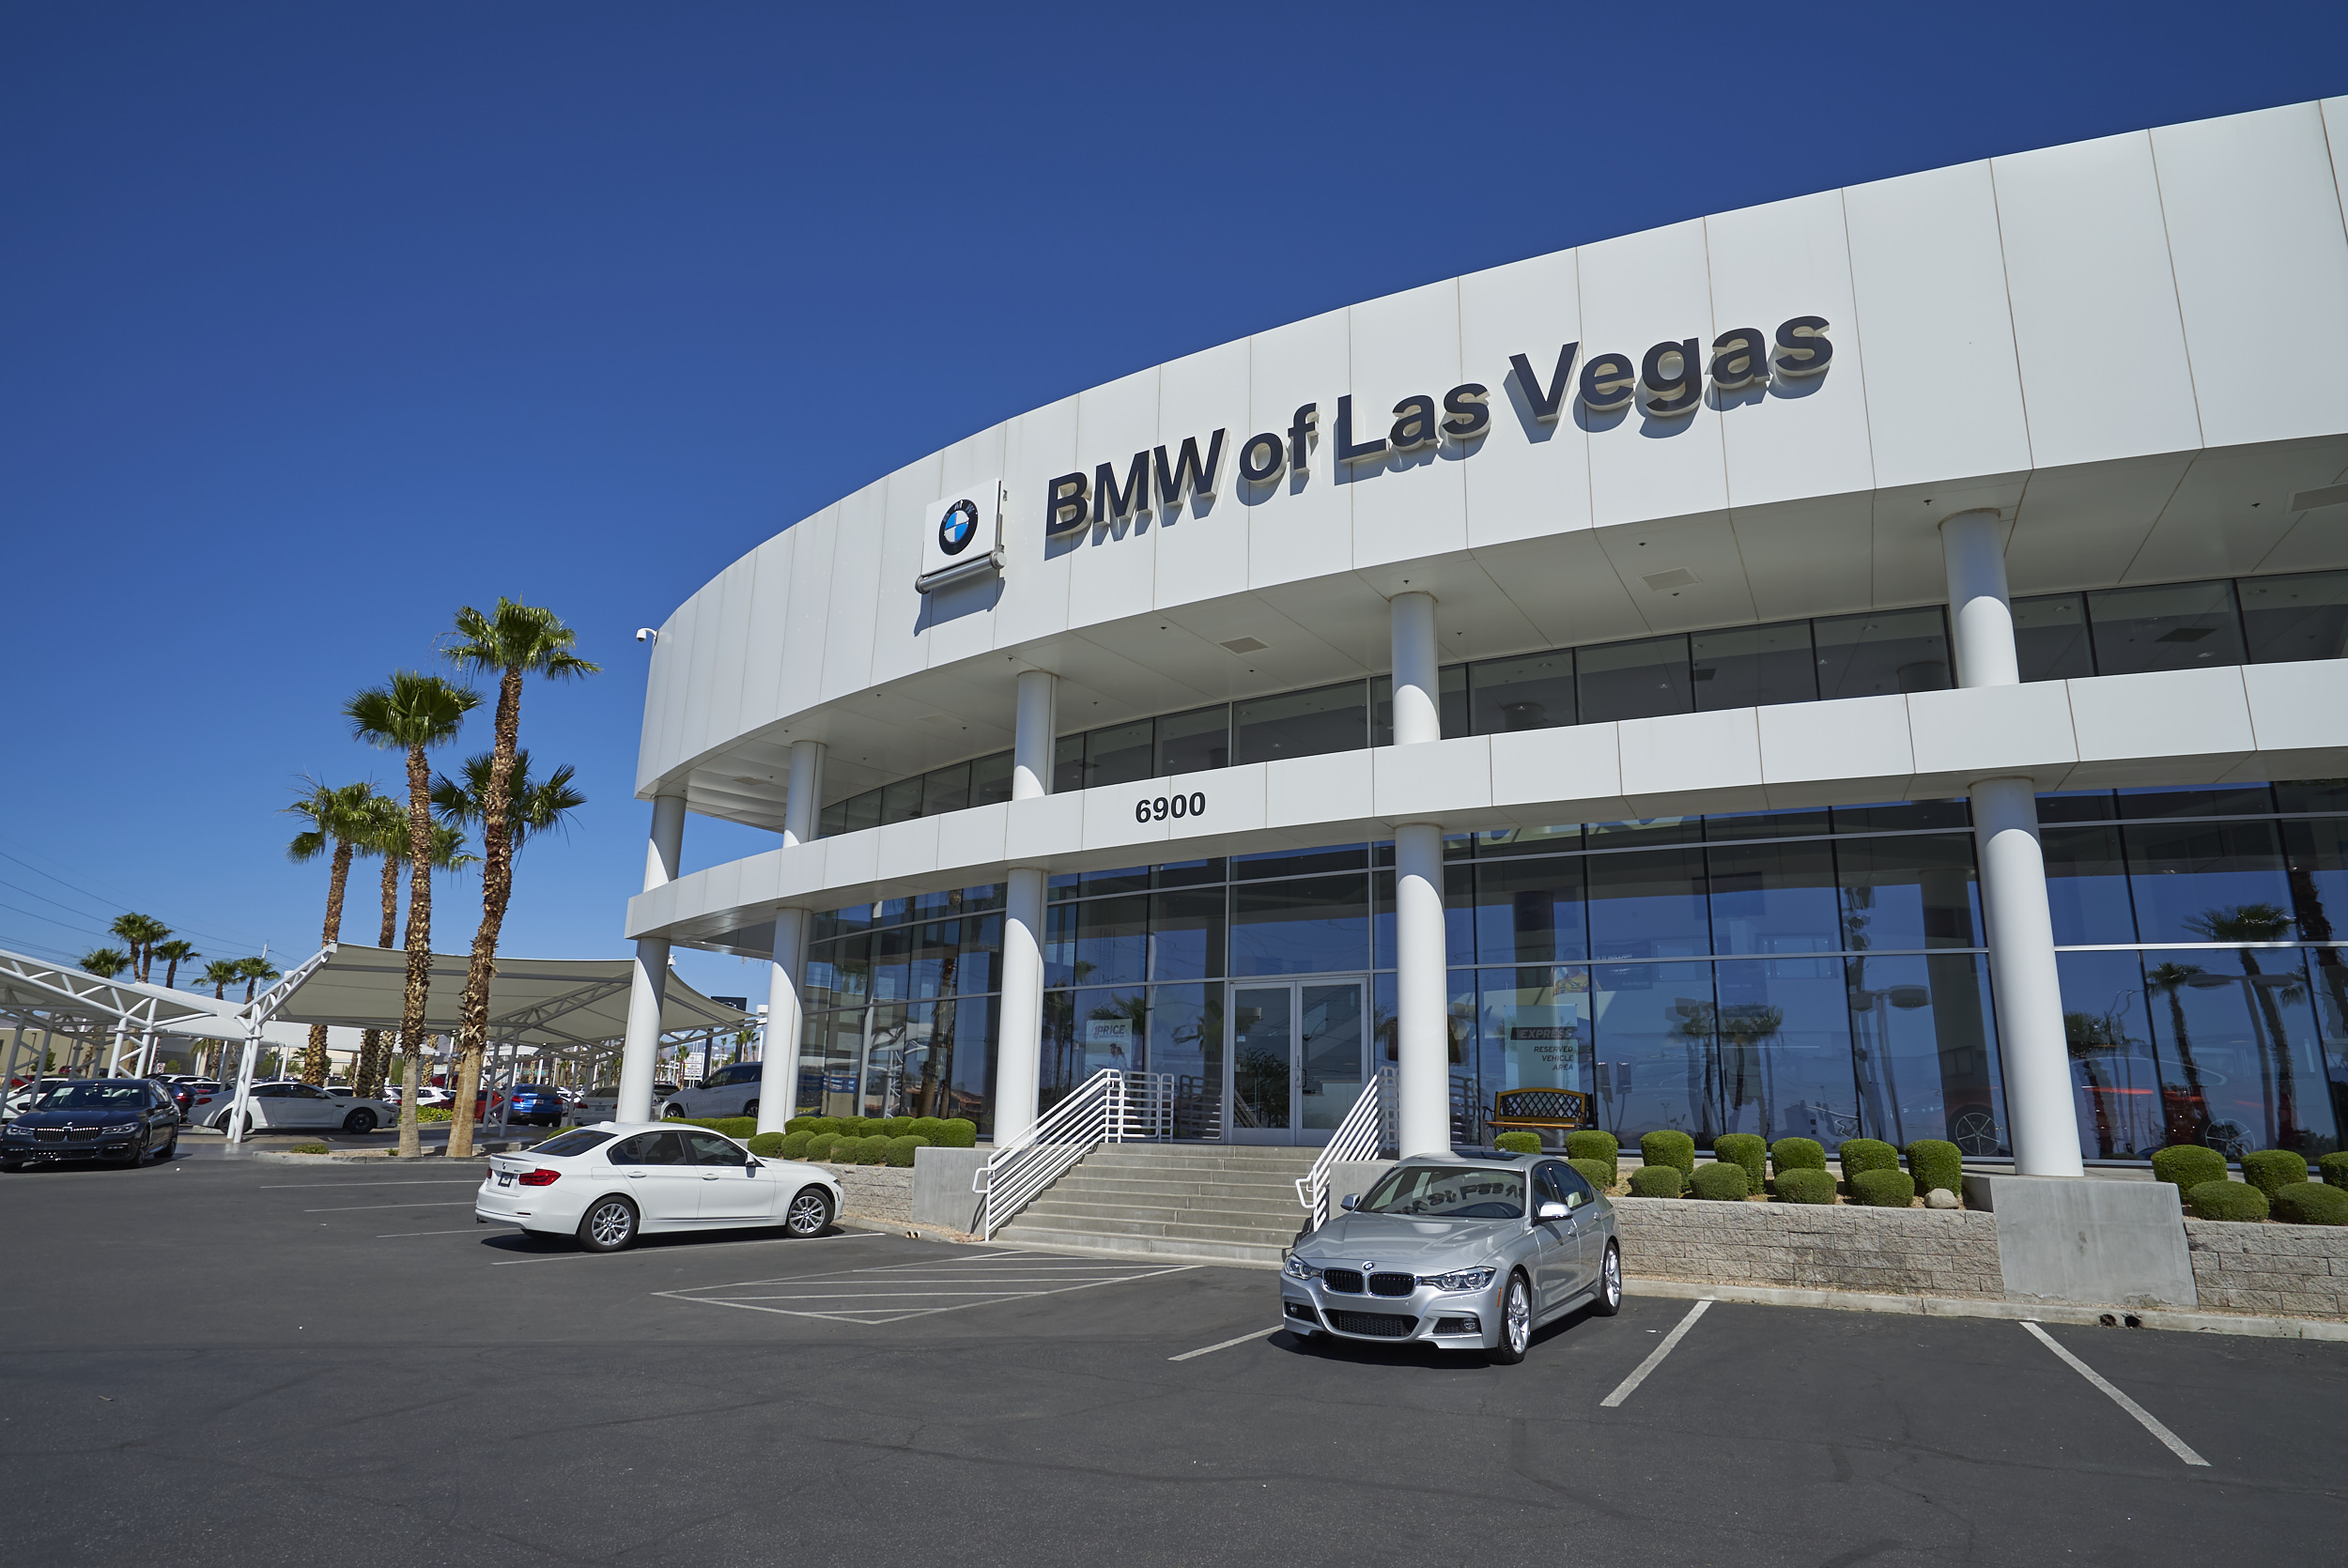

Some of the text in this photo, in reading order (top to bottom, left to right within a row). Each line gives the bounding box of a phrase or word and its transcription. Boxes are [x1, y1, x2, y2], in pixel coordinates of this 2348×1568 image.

[1045, 315, 1833, 539] BMW of Las Vegas
[1135, 792, 1206, 822] 6900
[1520, 1029, 1573, 1038] EXPRESS
